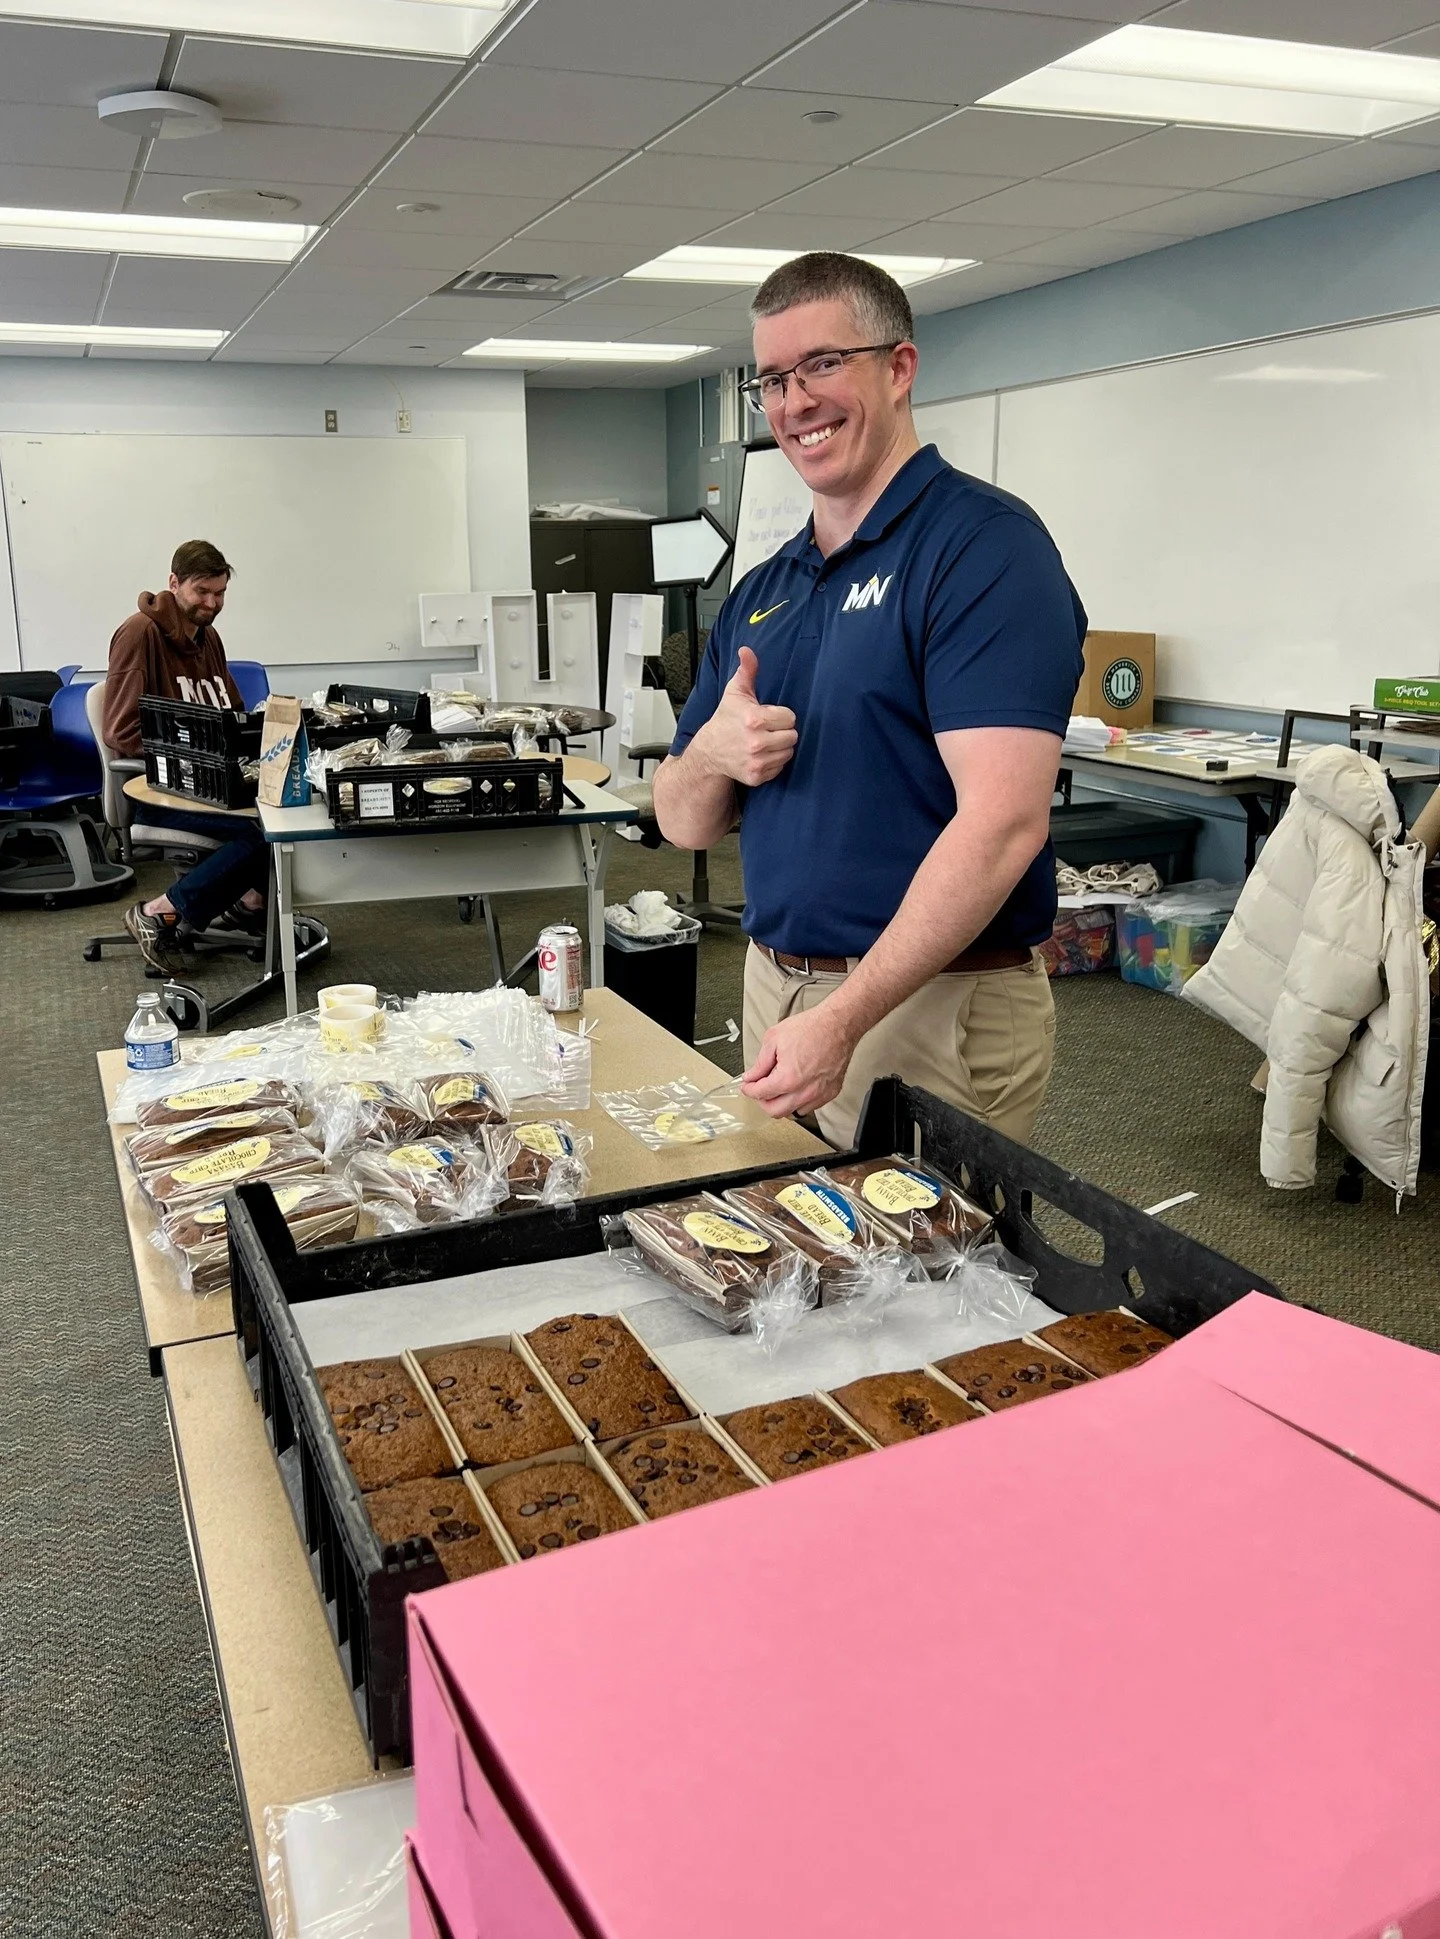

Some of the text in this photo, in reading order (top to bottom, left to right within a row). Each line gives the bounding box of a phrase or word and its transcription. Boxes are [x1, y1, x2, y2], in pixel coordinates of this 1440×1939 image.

[842, 572, 893, 612] MN
[189, 1148, 257, 1175] CHOCOLATE CHIP
[807, 1204, 831, 1226] BREAD
[815, 1189, 850, 1224] BREADSMITH
